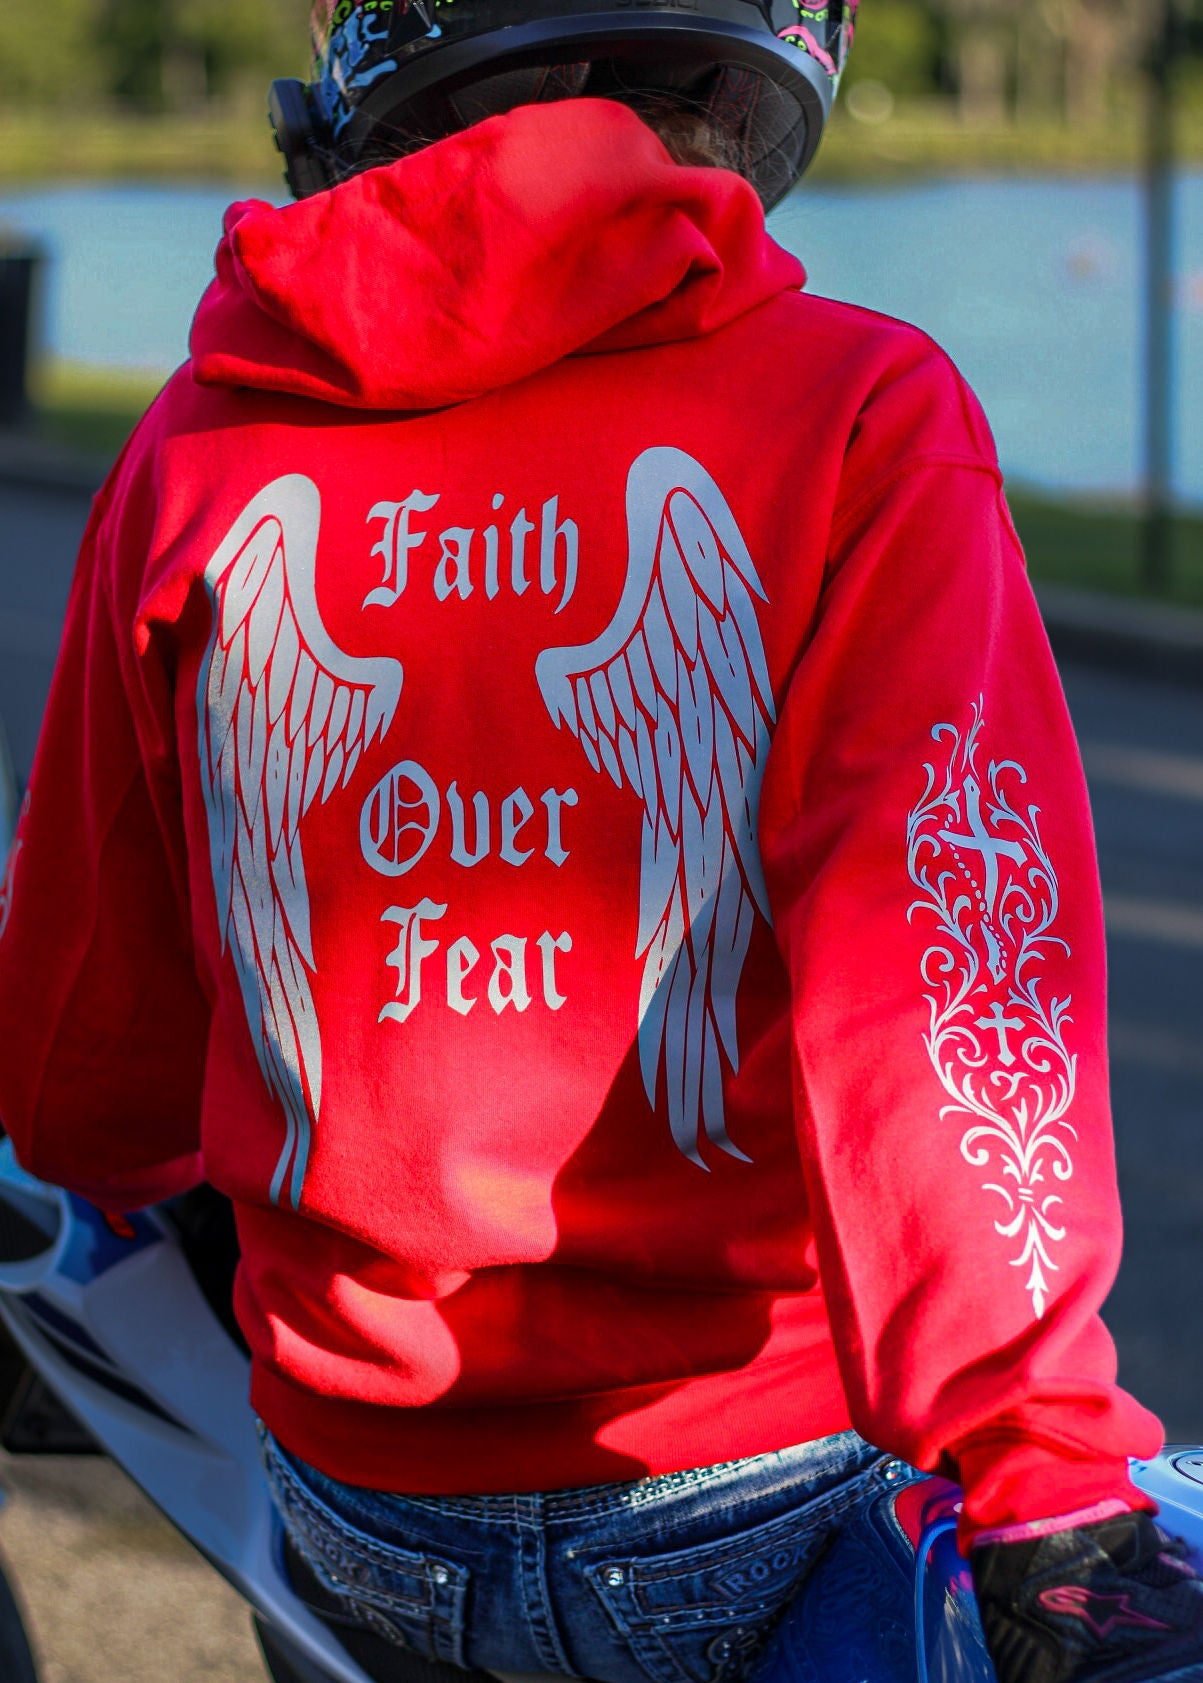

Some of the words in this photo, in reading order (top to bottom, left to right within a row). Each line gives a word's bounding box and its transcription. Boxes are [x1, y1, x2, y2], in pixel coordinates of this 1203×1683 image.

[362, 489, 578, 614] Faith
[359, 759, 579, 876] Over
[378, 897, 572, 1023] Fear
